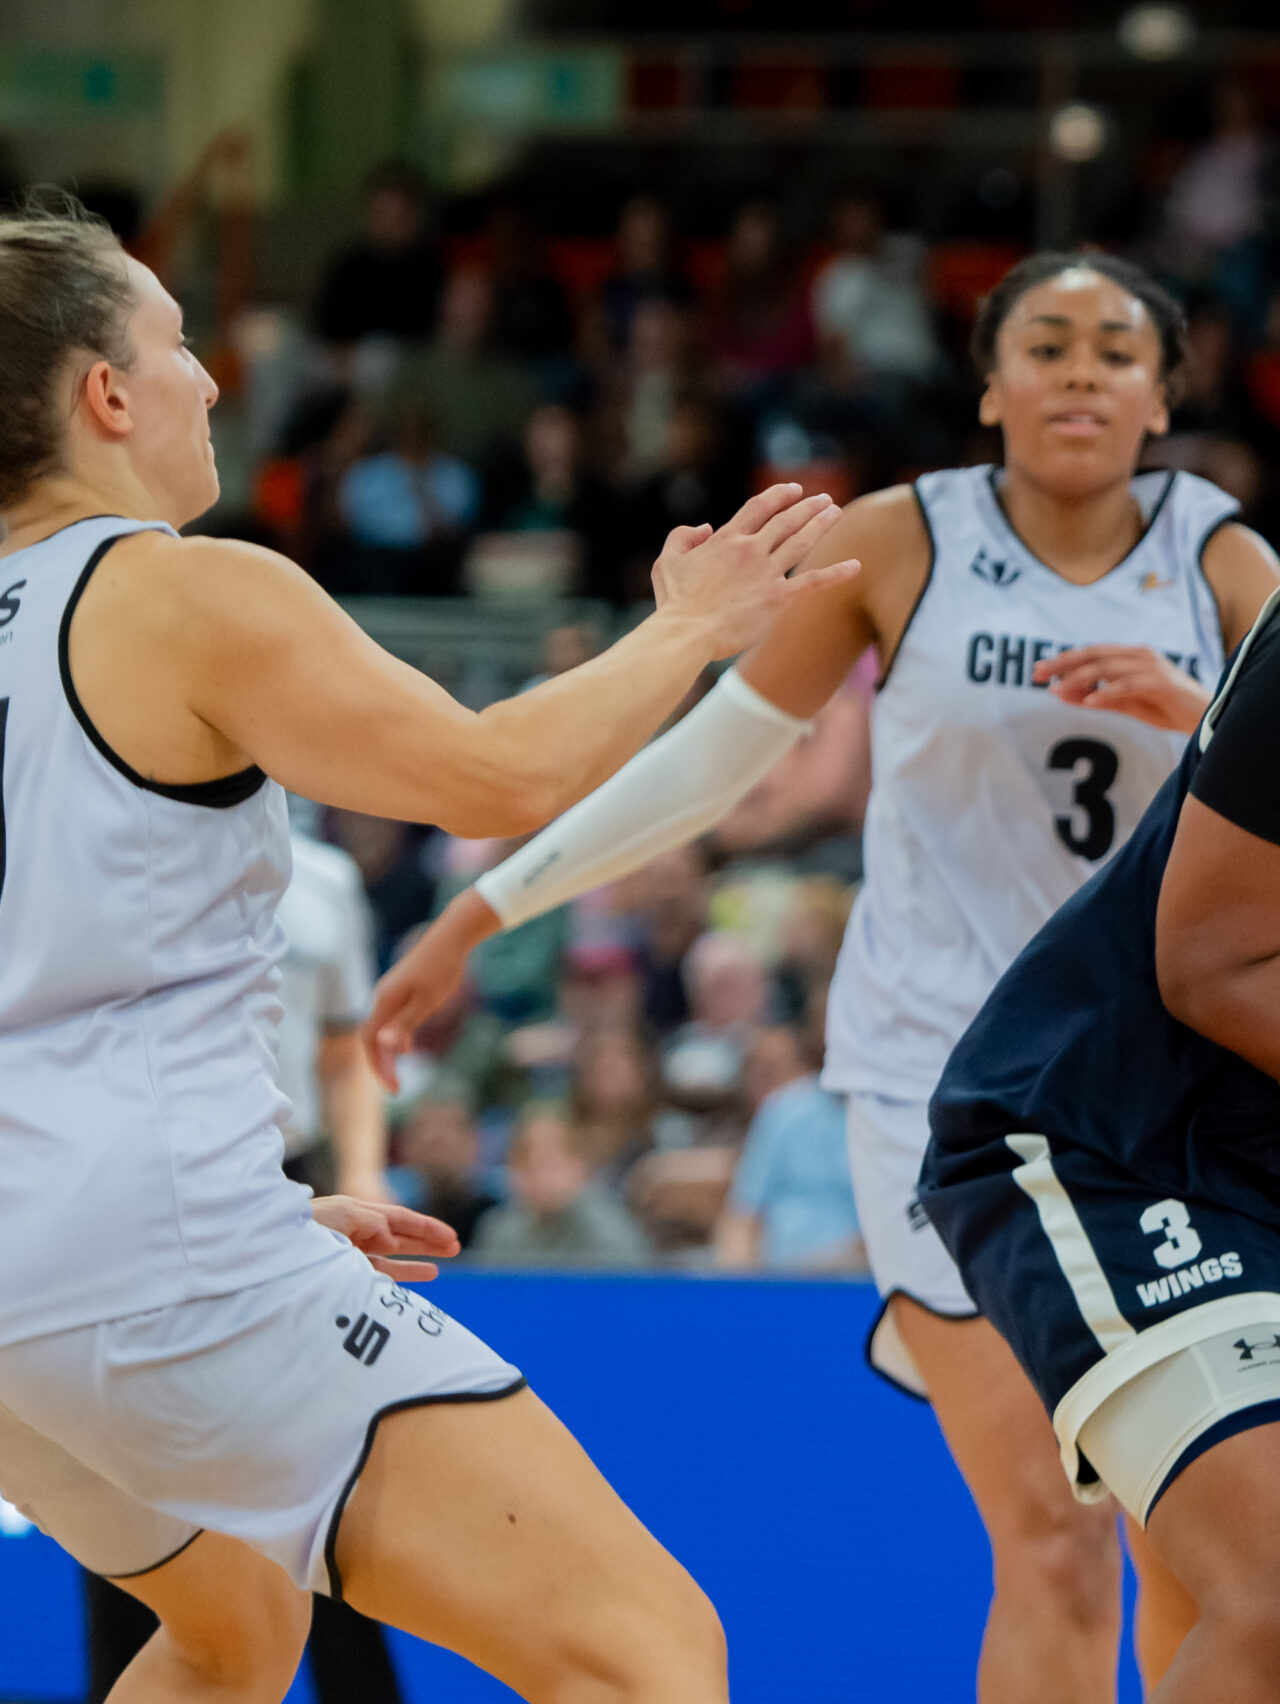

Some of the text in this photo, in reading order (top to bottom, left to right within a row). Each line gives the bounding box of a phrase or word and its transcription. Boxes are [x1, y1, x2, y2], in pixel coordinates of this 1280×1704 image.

[1045, 735, 1118, 863] 3
[1139, 1198, 1202, 1269] 3
[1136, 1251, 1244, 1308] WINGS
